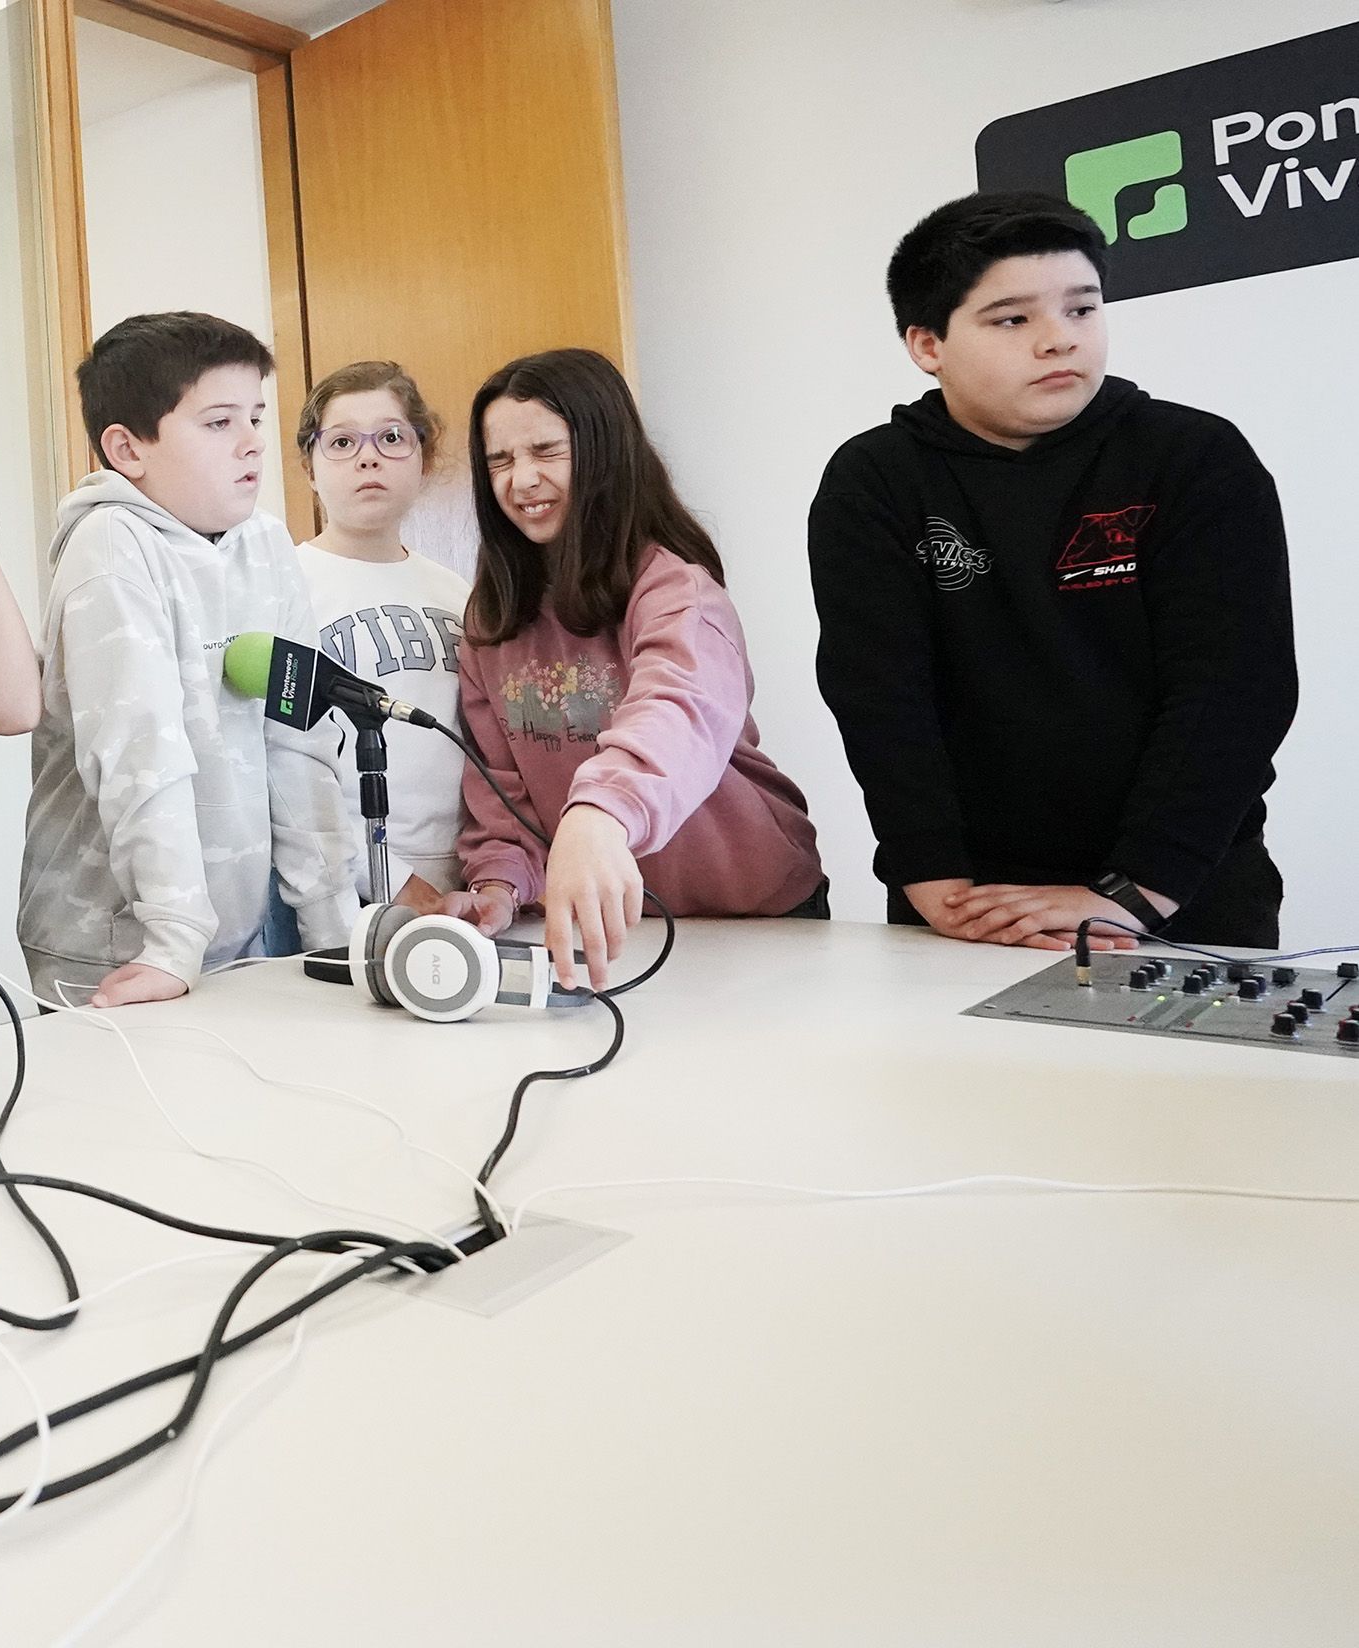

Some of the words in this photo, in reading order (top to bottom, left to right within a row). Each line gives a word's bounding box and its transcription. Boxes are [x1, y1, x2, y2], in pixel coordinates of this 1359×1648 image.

[282, 653, 293, 698] Pontevedra
[522, 720, 562, 752] Happy
[431, 954, 441, 985] AKG
